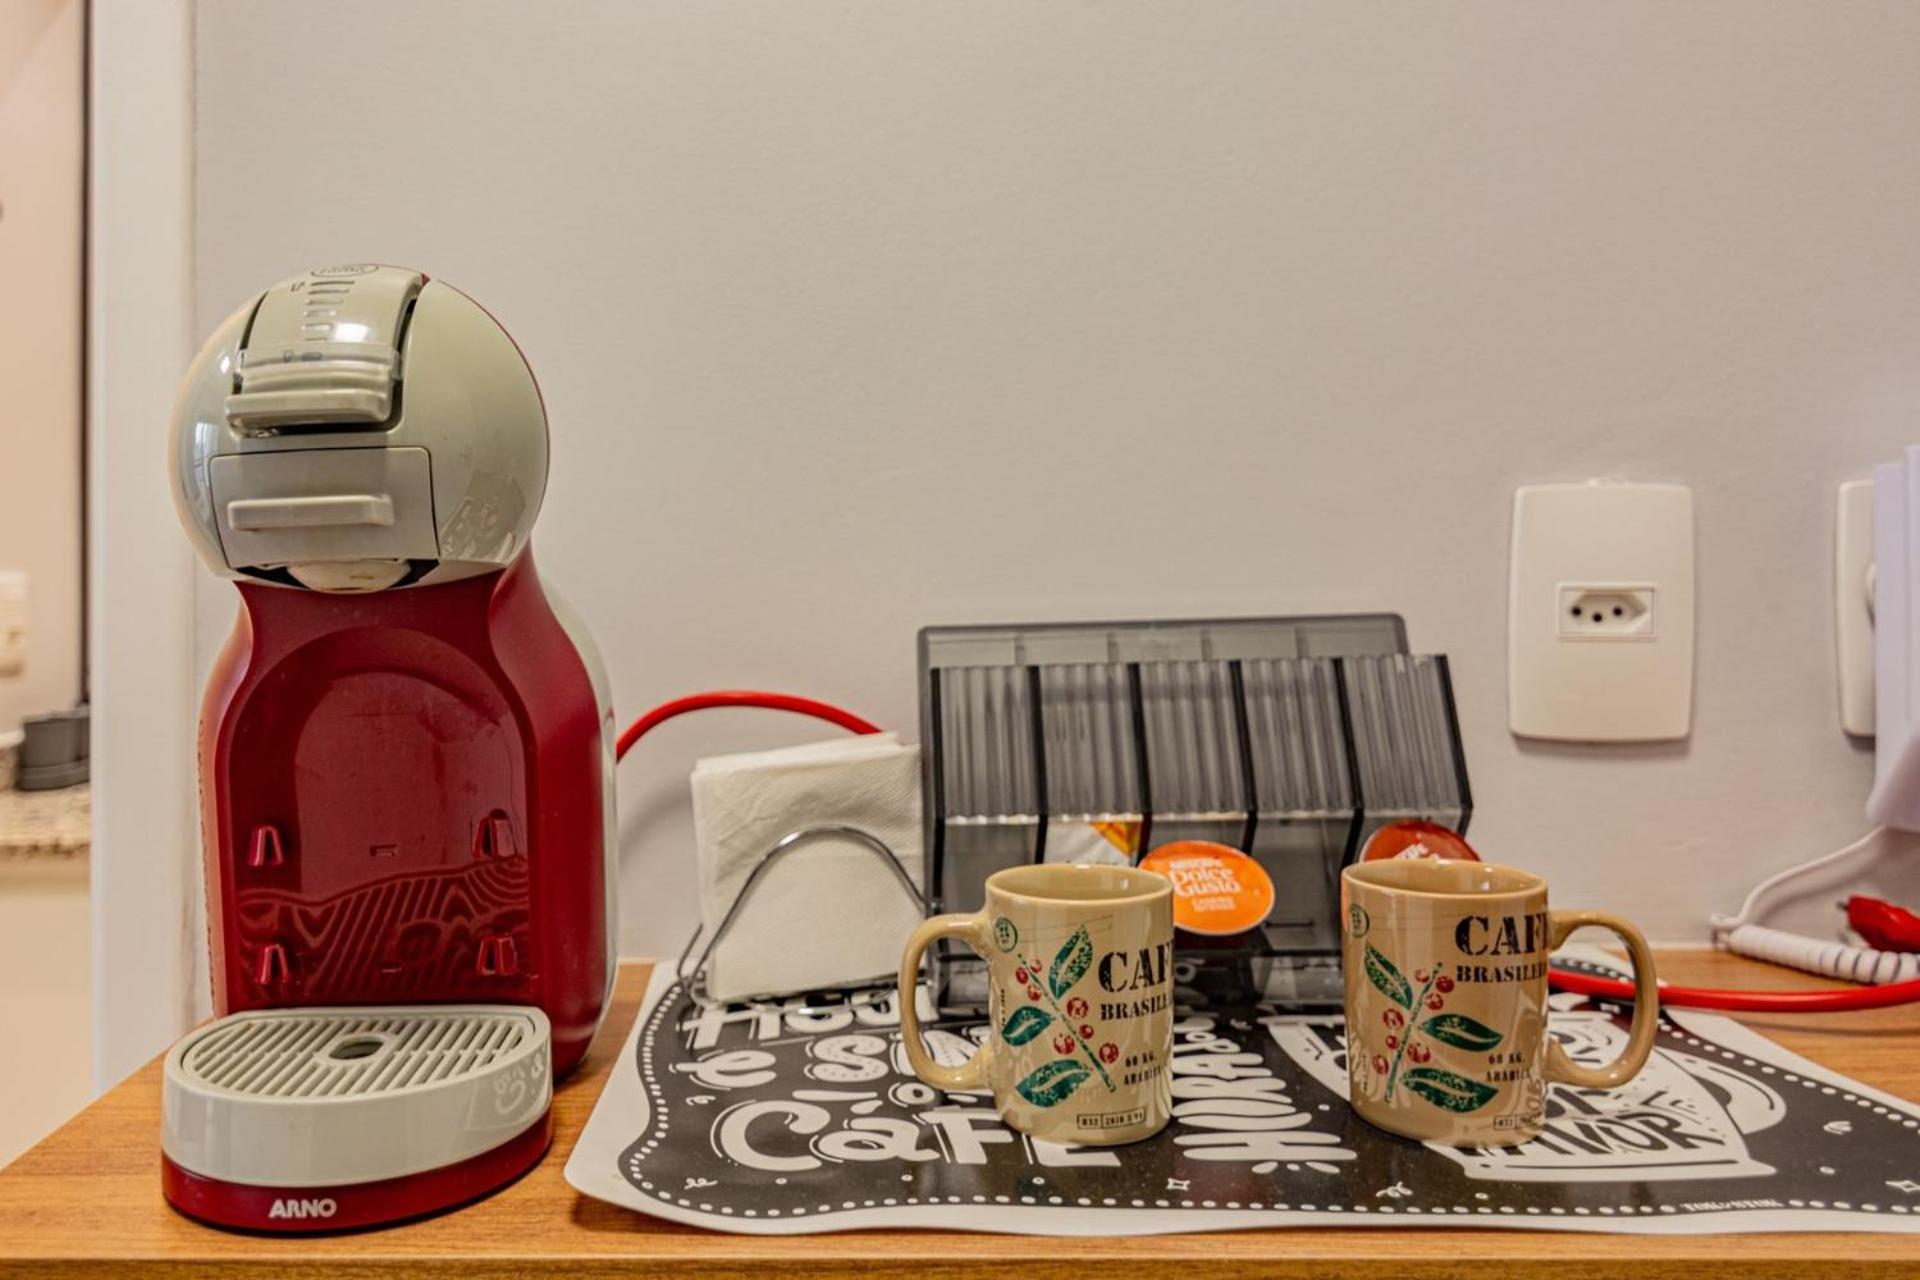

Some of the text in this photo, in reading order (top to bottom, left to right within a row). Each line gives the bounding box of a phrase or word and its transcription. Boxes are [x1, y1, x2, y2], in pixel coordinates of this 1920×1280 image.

[1168, 867, 1234, 884] Dolce
[1172, 879, 1241, 896] Gusto
[268, 1198, 338, 1219] ARNO
